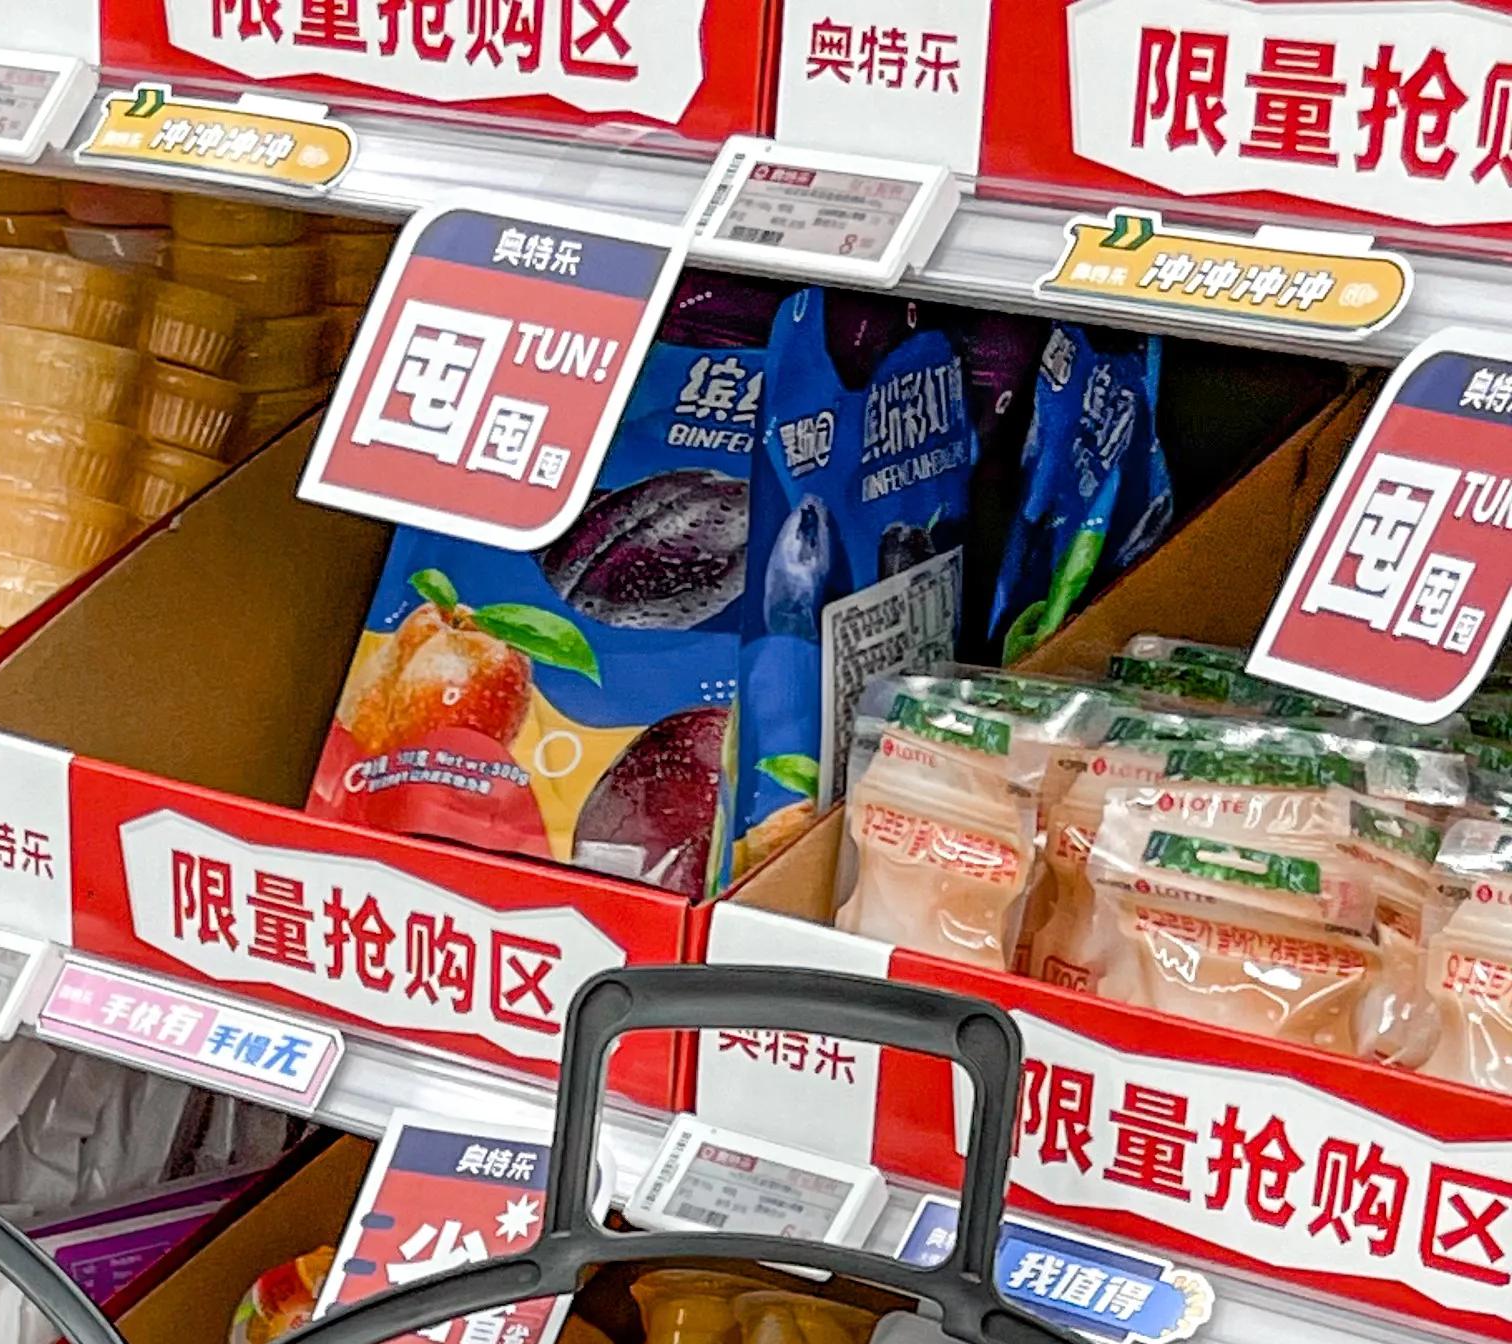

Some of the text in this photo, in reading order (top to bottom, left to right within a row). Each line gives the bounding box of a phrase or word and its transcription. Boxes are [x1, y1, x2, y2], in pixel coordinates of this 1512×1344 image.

[806, 16, 961, 95] 奥特乐
[149, 119, 296, 168] 冲冲冲冲
[494, 227, 585, 277] 奥特乐
[1137, 252, 1336, 311] 冲冲冲冲
[511, 321, 620, 386] TUN!
[1459, 368, 1512, 416] 奥特
[1154, 884, 1219, 905] LOTTE
[170, 849, 565, 1035] 限量抢购区
[101, 996, 203, 1045] 手快有
[207, 1023, 313, 1078] 手慢无
[456, 1143, 538, 1181] 奥特乐
[1010, 1058, 1512, 1287] 限量抢购区
[1007, 1250, 1156, 1322] 我值得
